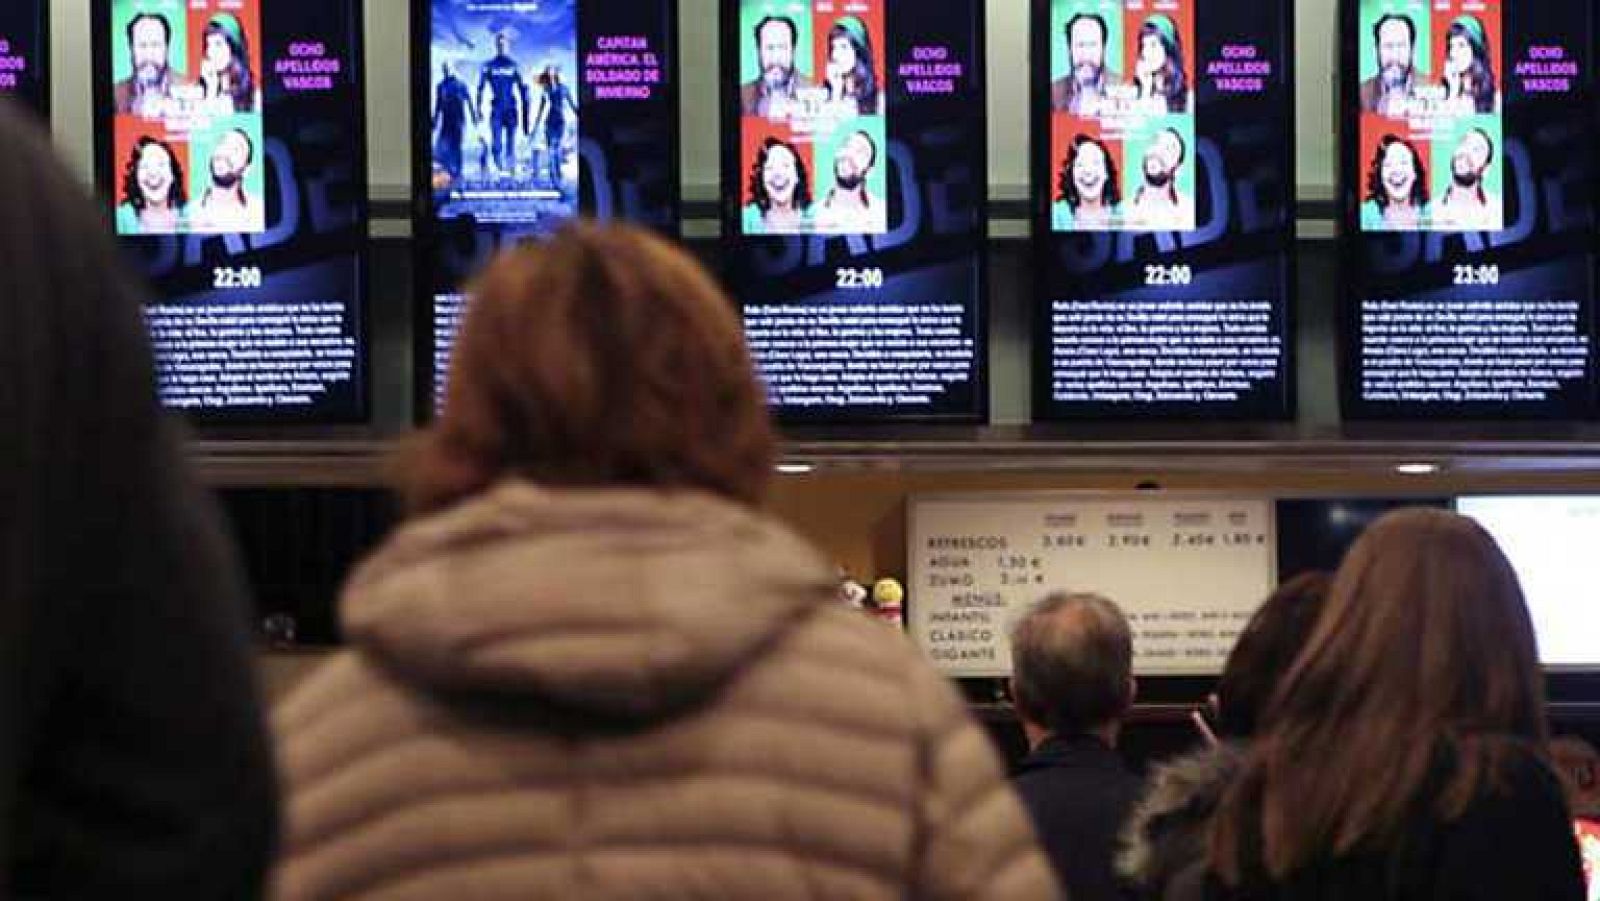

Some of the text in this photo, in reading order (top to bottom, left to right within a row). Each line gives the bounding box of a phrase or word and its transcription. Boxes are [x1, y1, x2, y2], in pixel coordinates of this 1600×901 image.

[289, 42, 324, 56] OCHO
[913, 46, 948, 59] OCHO
[1221, 45, 1256, 58] OCHO
[1529, 46, 1564, 59] OCHO
[274, 59, 340, 73] APELLIDOS
[898, 63, 962, 76] APELLIDOS
[1207, 61, 1271, 75] APELLIDOS
[1515, 61, 1578, 75] APELLIDOS
[586, 68, 640, 82] SOLDADO
[283, 76, 332, 90] VASCOS
[906, 79, 953, 92] VASCOS
[1215, 78, 1263, 91] VASCOS
[1523, 78, 1569, 91] VASCOS
[213, 267, 262, 288] 22:00
[835, 267, 883, 288] 22:00
[1144, 264, 1192, 285] 22:00
[1453, 264, 1499, 285] 23:00
[928, 535, 1007, 549] REFRESCOS
[929, 556, 969, 568] AGUA
[929, 573, 973, 586] ZUMO
